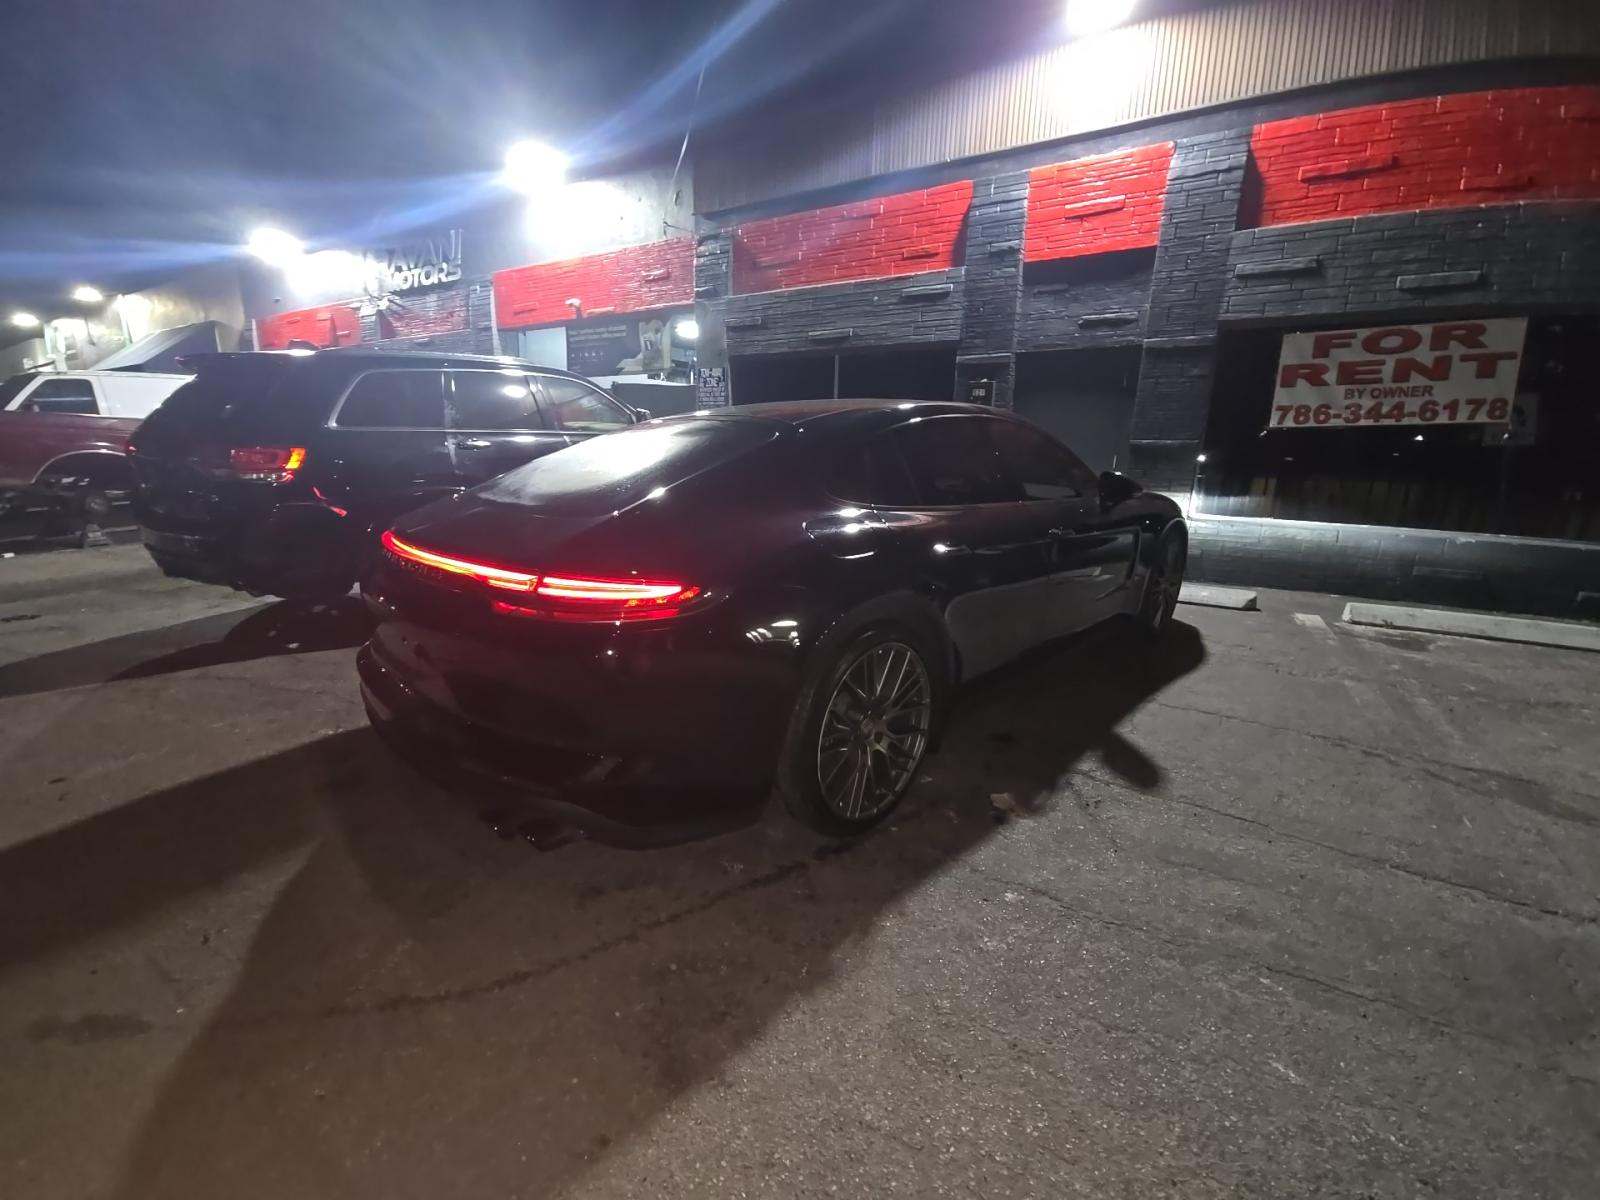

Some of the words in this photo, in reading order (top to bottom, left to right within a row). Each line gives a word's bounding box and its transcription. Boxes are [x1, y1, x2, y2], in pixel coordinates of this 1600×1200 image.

[1312, 322, 1489, 360] FOR
[1279, 351, 1518, 389] RENT
[1344, 387, 1366, 401] BY
[1370, 384, 1435, 400] OWNER
[1274, 397, 1510, 426] 786-344-6178
